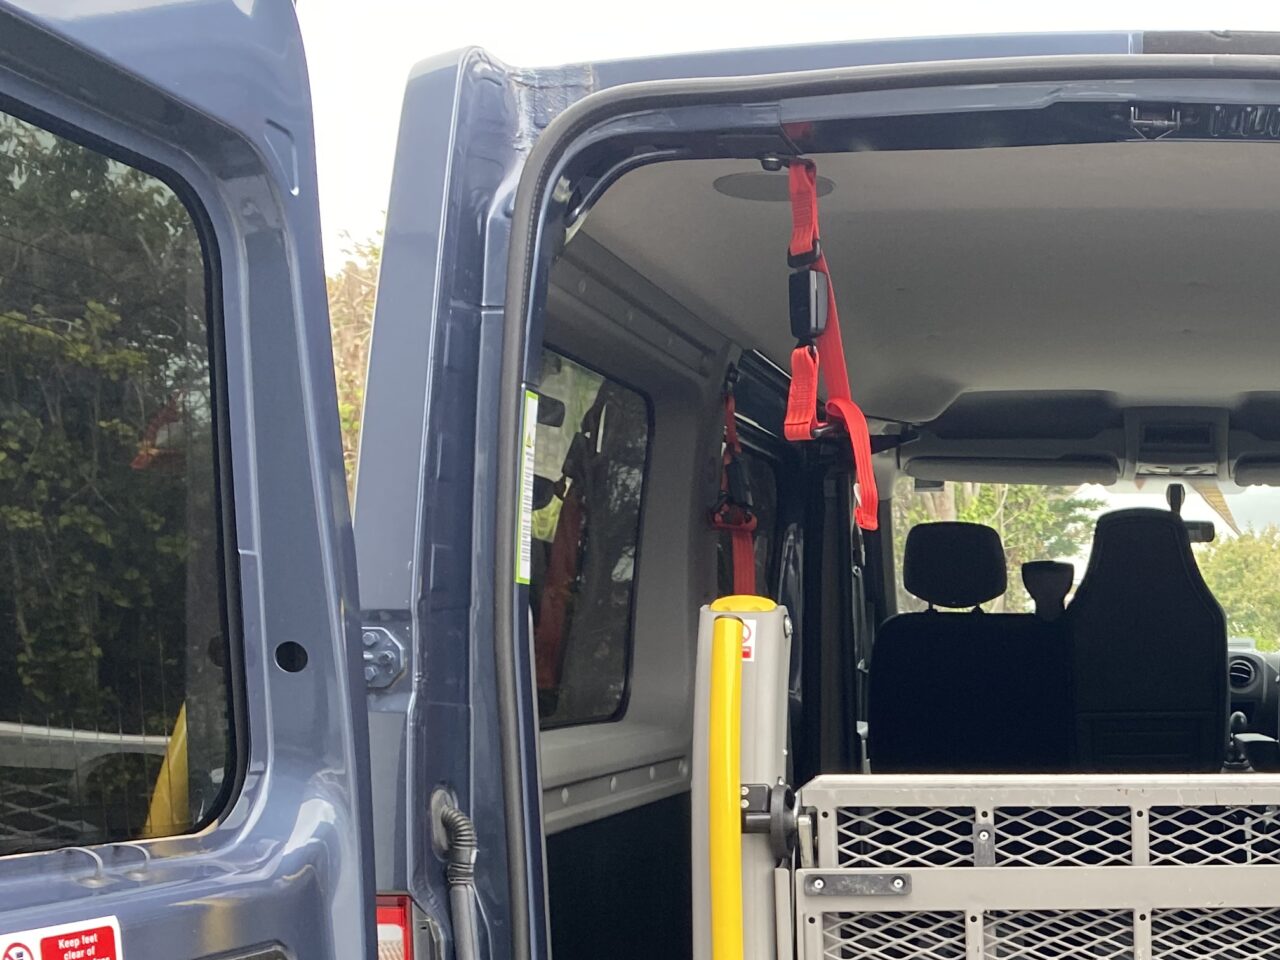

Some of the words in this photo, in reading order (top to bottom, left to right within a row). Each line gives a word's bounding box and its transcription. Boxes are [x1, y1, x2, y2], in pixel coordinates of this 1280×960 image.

[58, 937, 80, 949] Keep
[81, 933, 98, 945] feet
[63, 949, 85, 960] clear
[86, 945, 96, 956] of
